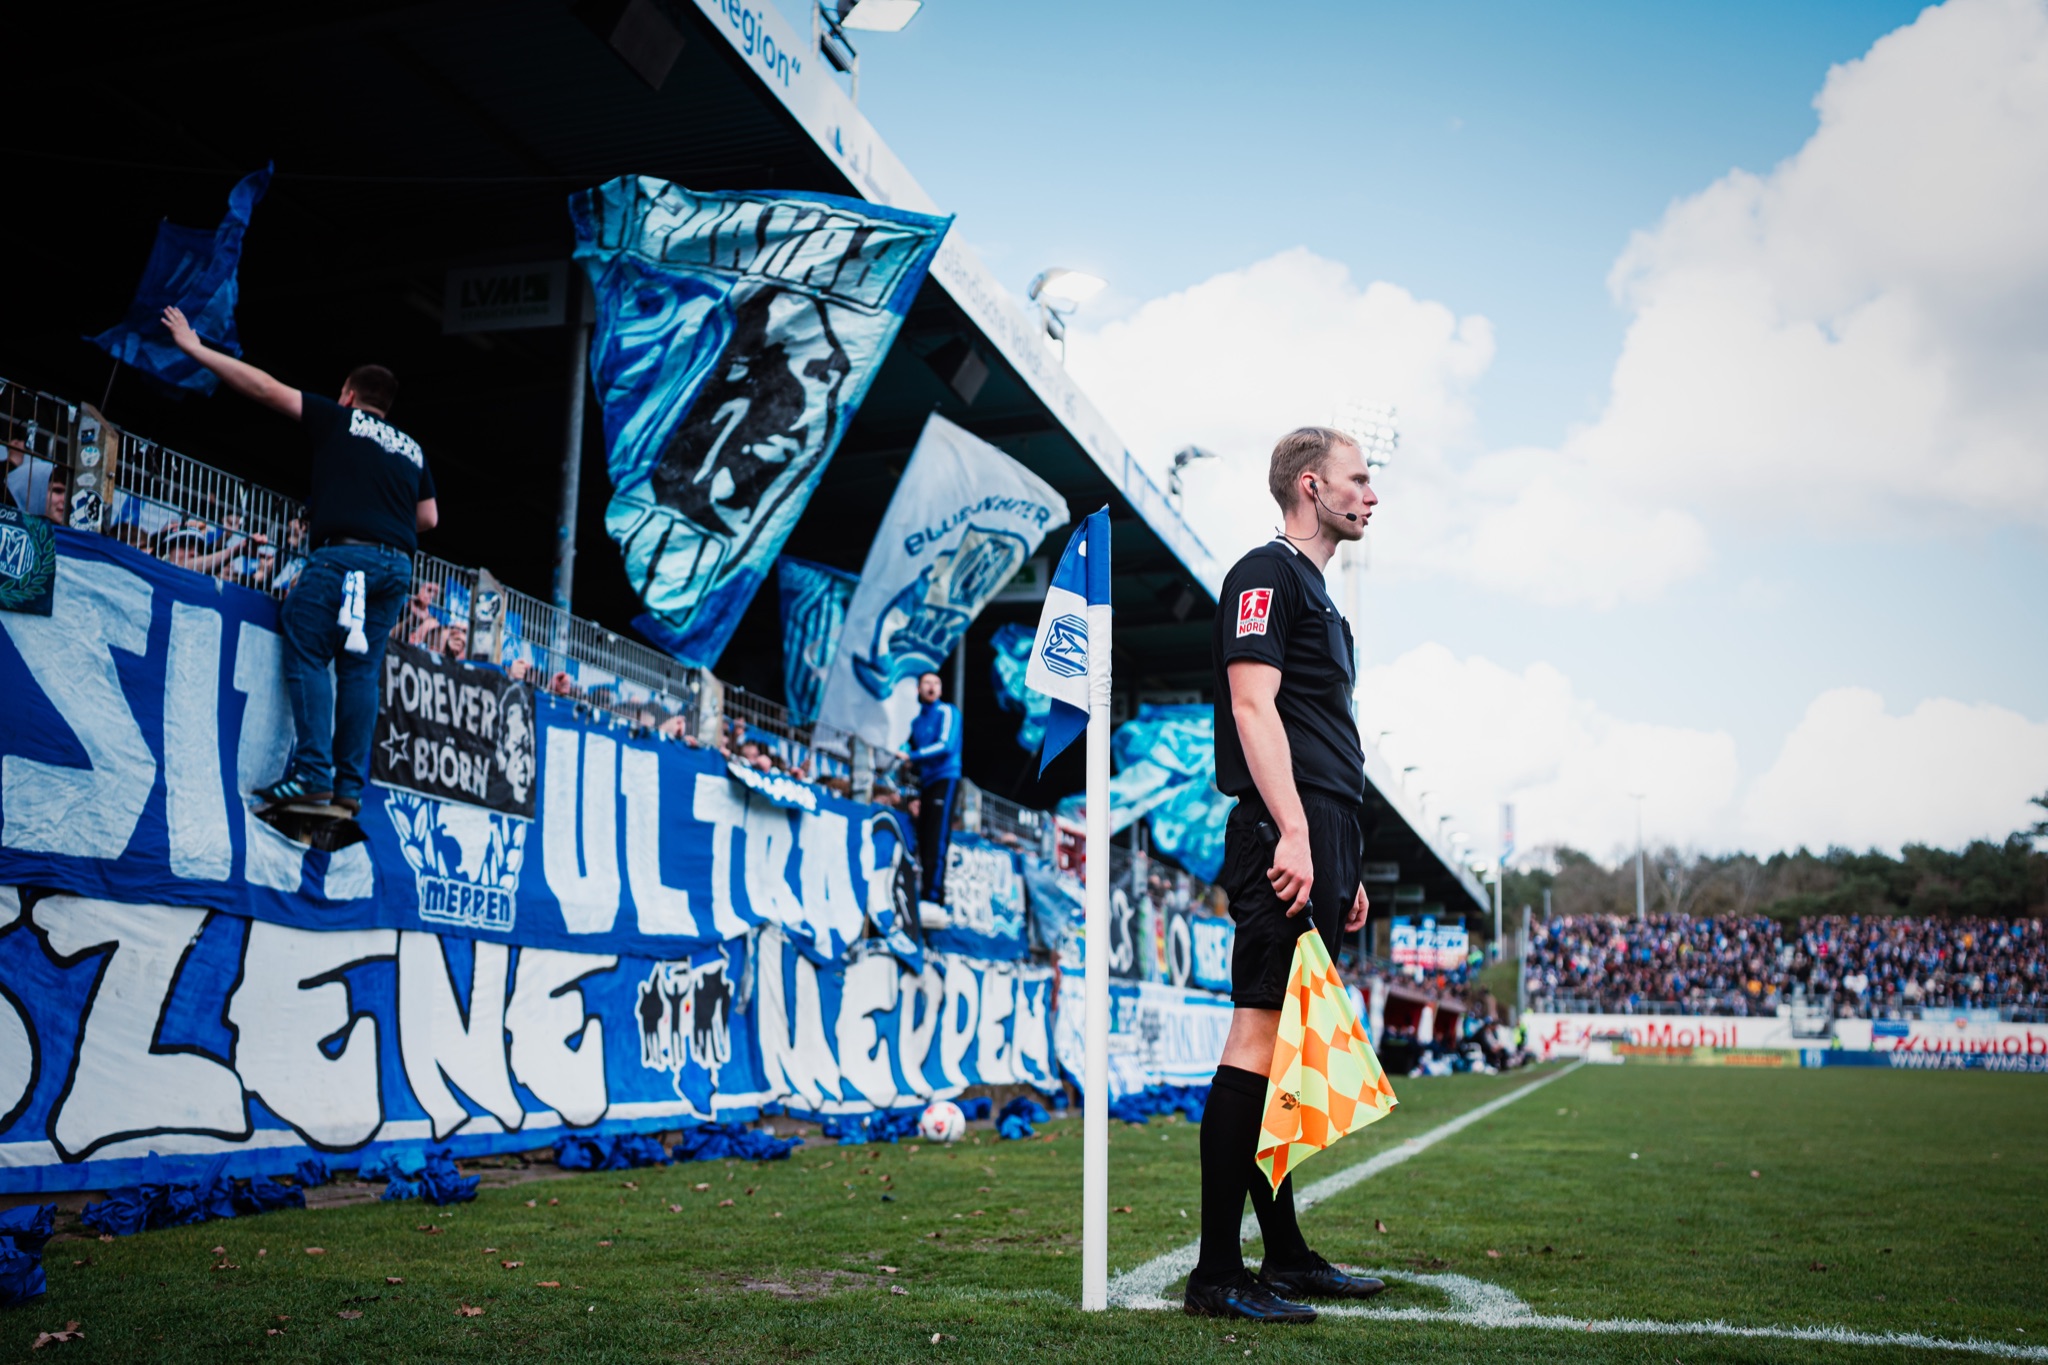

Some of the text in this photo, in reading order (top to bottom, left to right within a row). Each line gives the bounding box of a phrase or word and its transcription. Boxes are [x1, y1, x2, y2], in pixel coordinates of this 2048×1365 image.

[713, 0, 801, 87] egion“
[461, 275, 527, 309] LVM
[1239, 622, 1265, 634] NORD
[386, 654, 497, 740] FOREVER
[414, 736, 490, 799] BJÖRN
[425, 879, 511, 924] MEPPEN
[757, 930, 1060, 1110] MEPPEN
